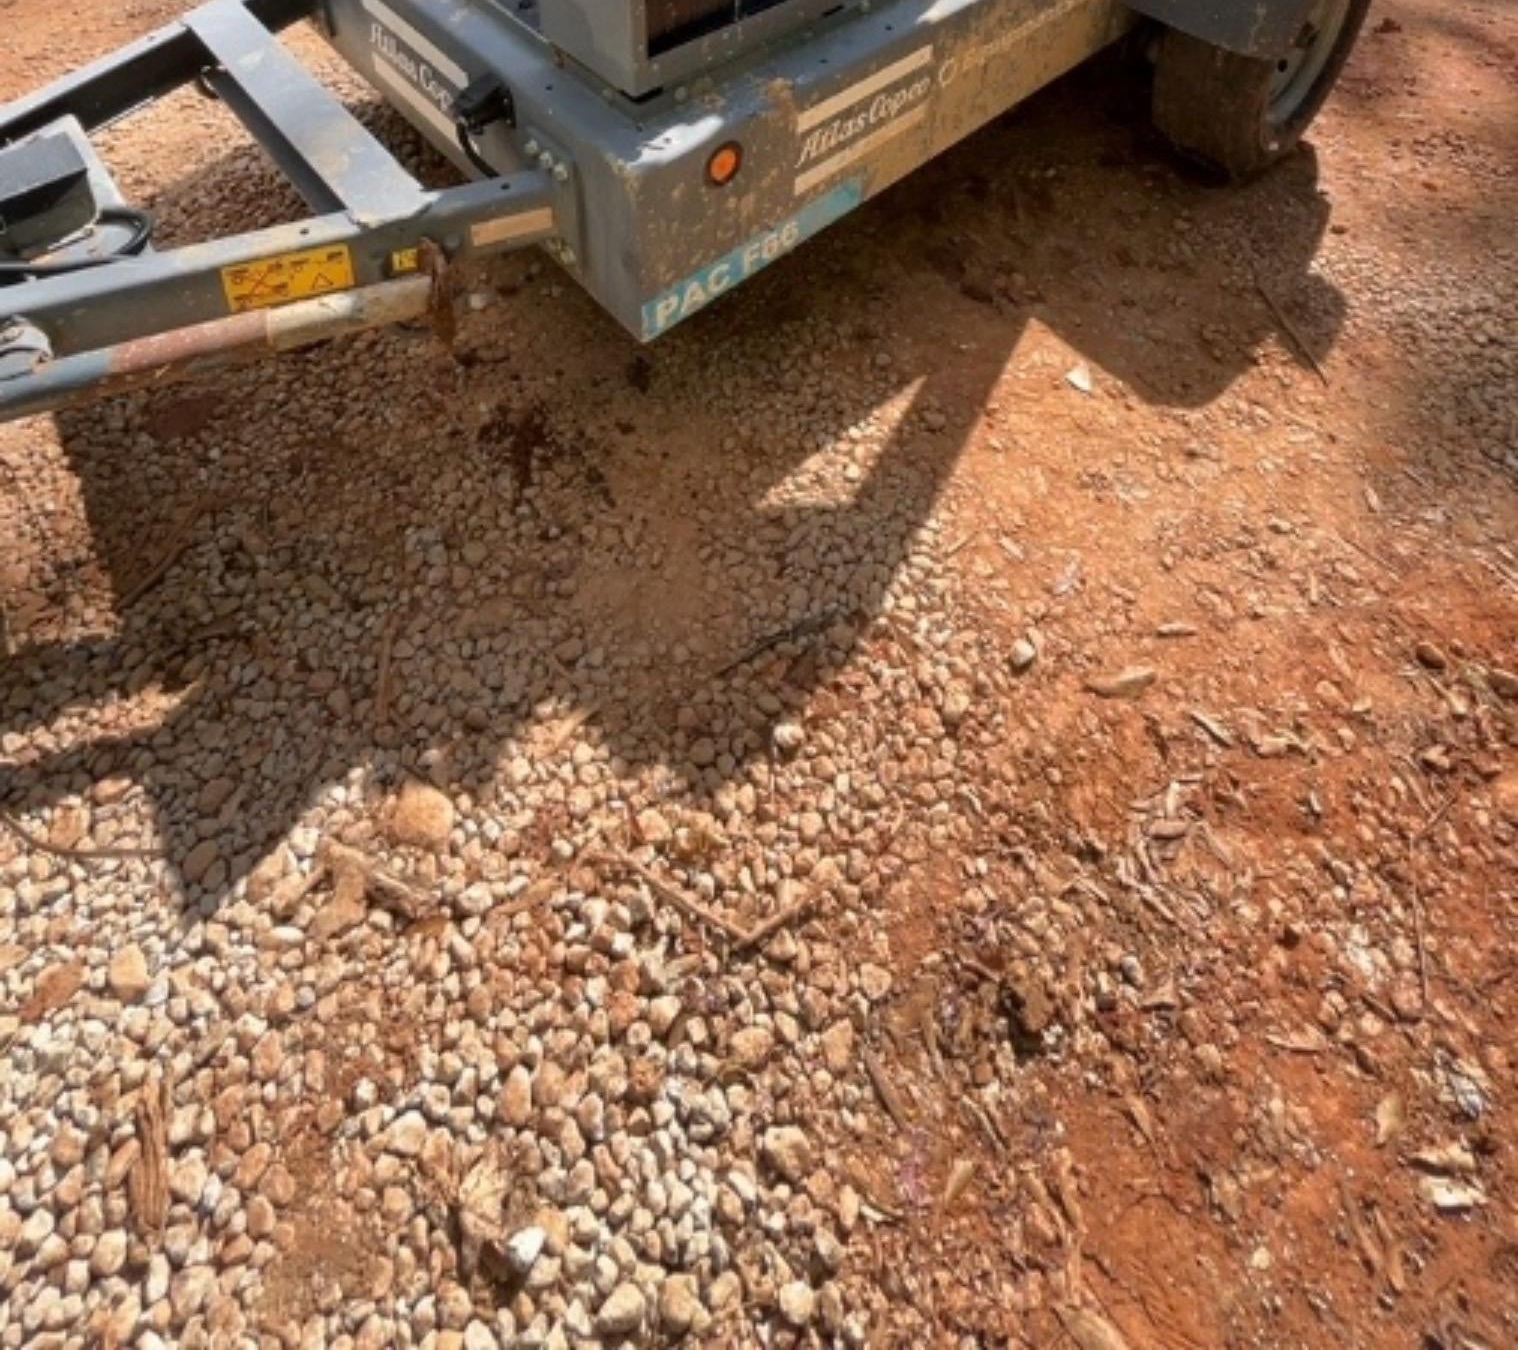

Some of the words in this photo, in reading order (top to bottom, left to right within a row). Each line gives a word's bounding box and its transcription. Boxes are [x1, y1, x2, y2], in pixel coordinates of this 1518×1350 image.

[794, 112, 868, 168] Atlas
[869, 77, 931, 124] Copco
[656, 262, 731, 330] PAC
